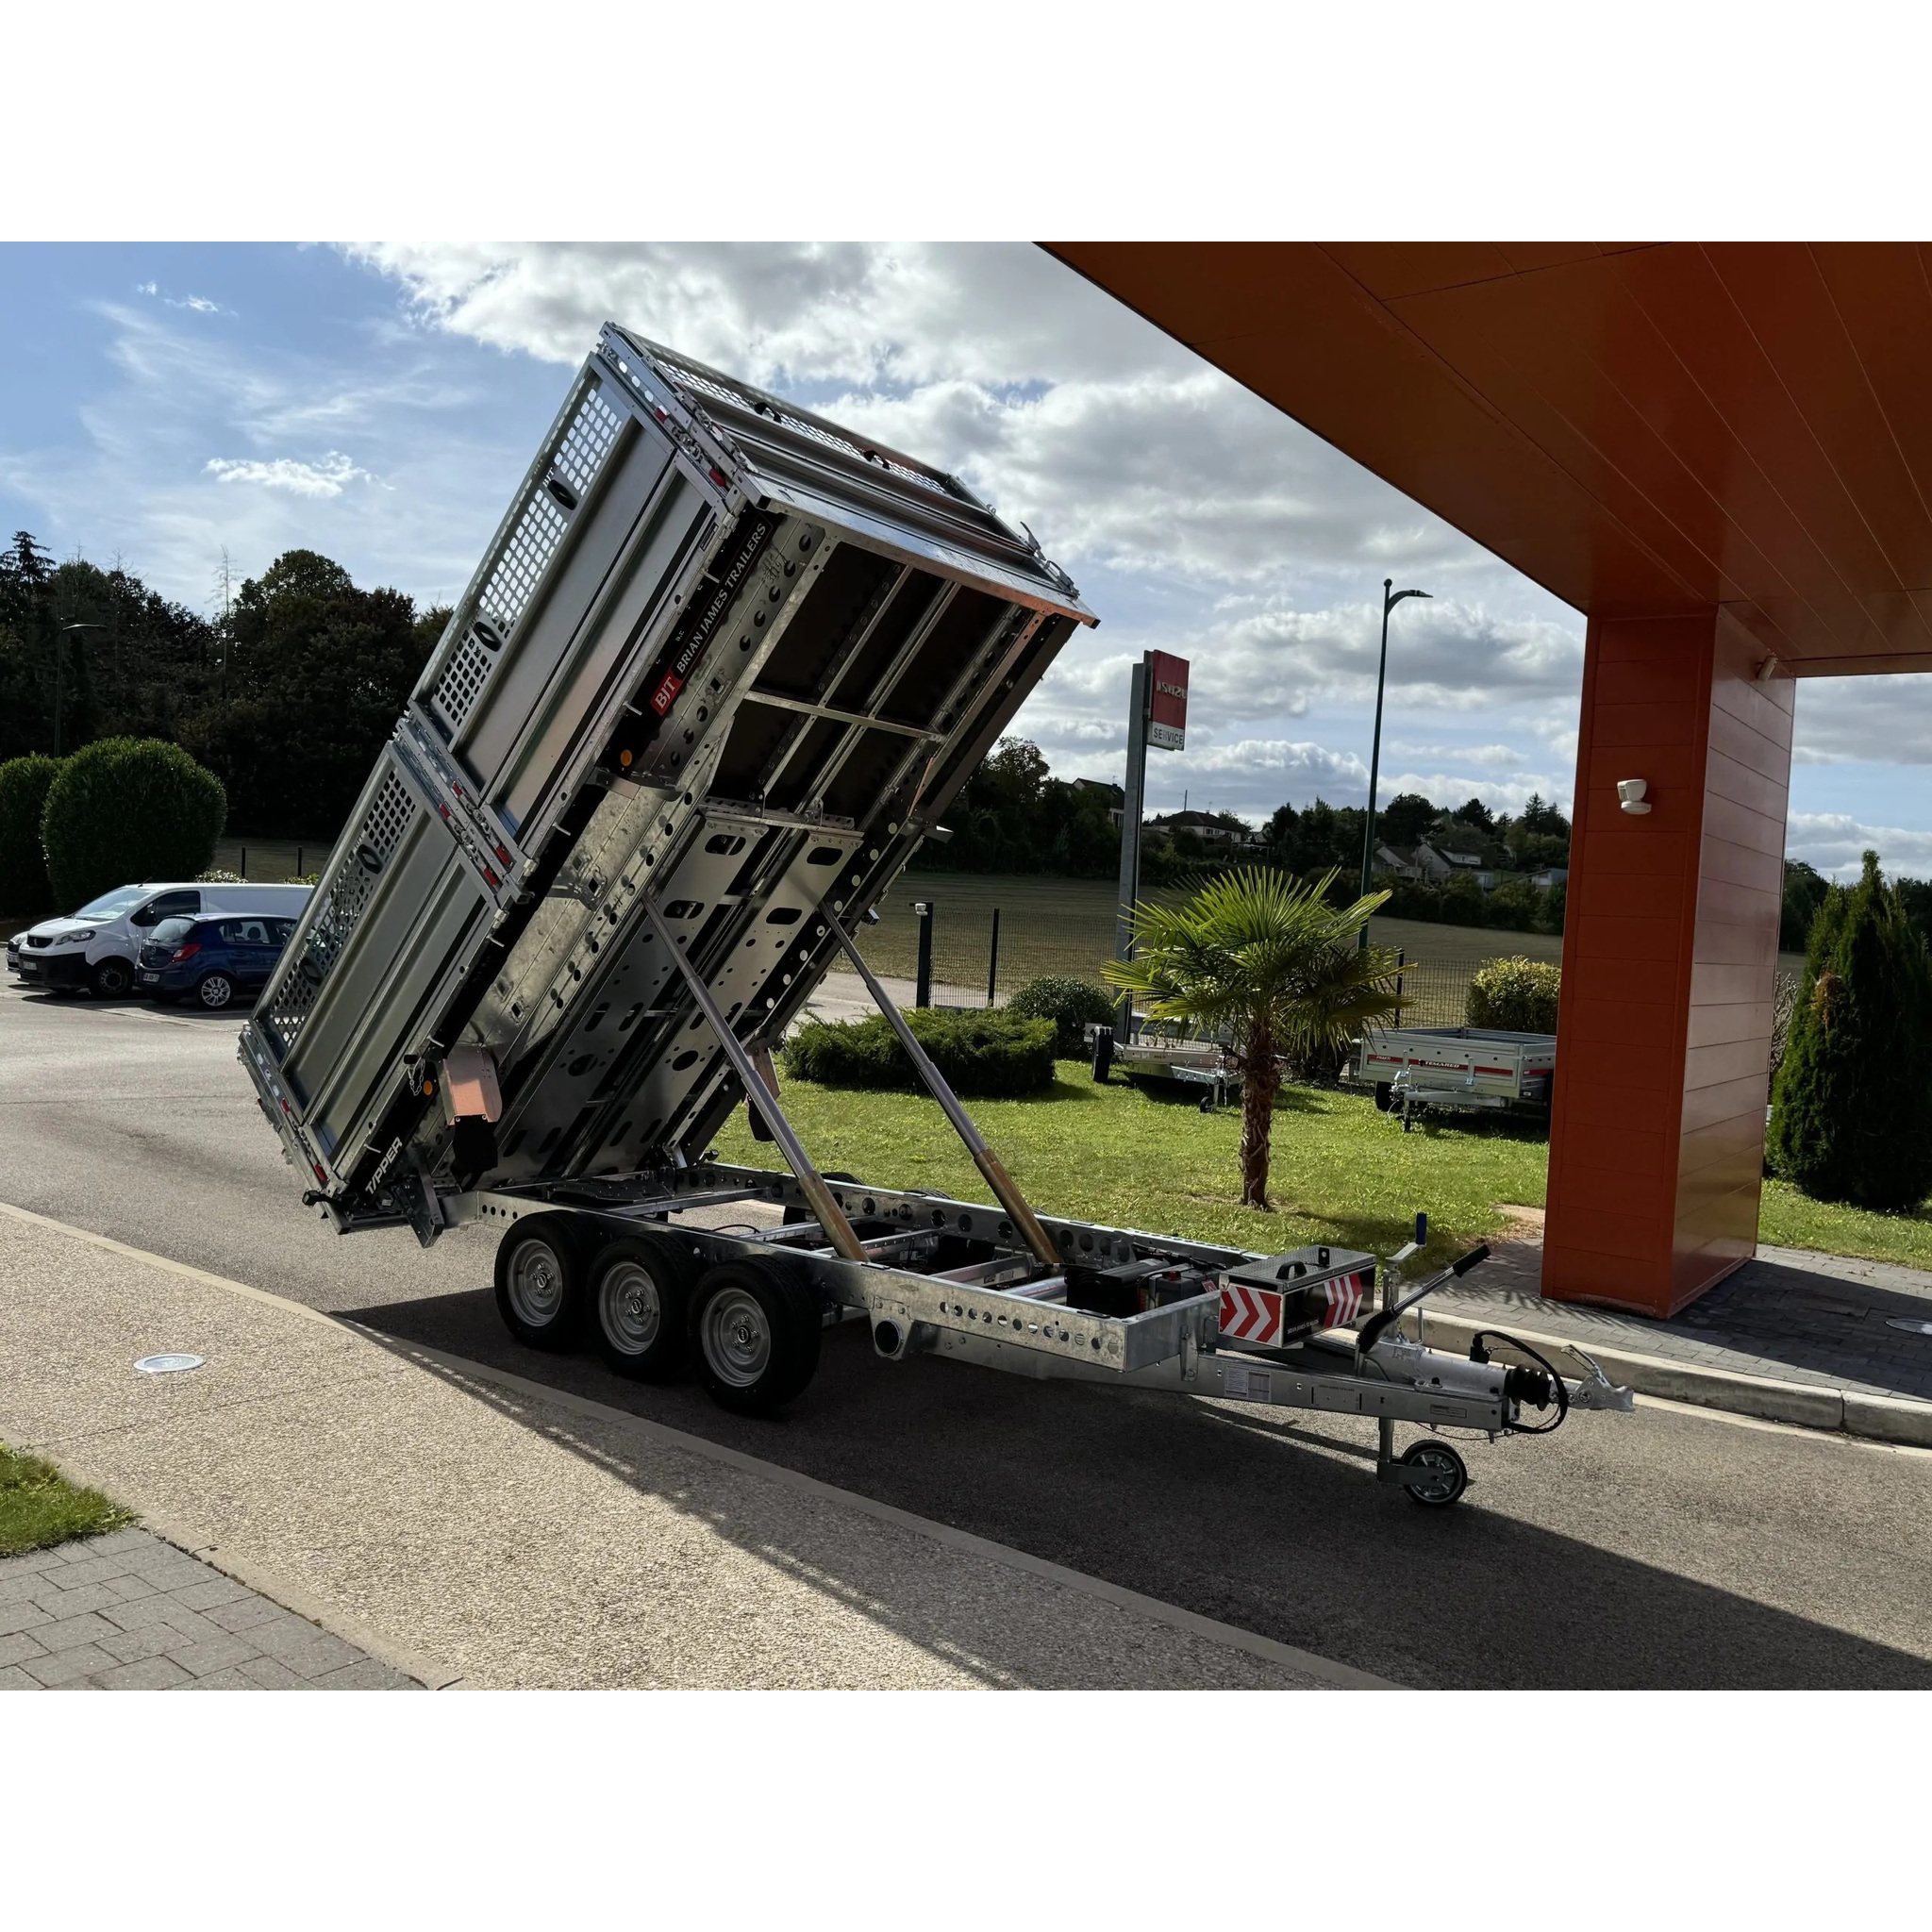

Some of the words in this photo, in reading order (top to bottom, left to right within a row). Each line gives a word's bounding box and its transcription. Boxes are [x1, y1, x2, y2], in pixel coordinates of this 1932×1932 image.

[655, 676, 676, 708] BJT
[675, 632, 704, 674] BRIAN
[700, 589, 728, 635] JAMES
[724, 523, 767, 590] TRAILERS
[1156, 680, 1188, 699] ISUZU
[1154, 727, 1184, 745] SERVICE
[365, 1137, 403, 1195] TIPPER
